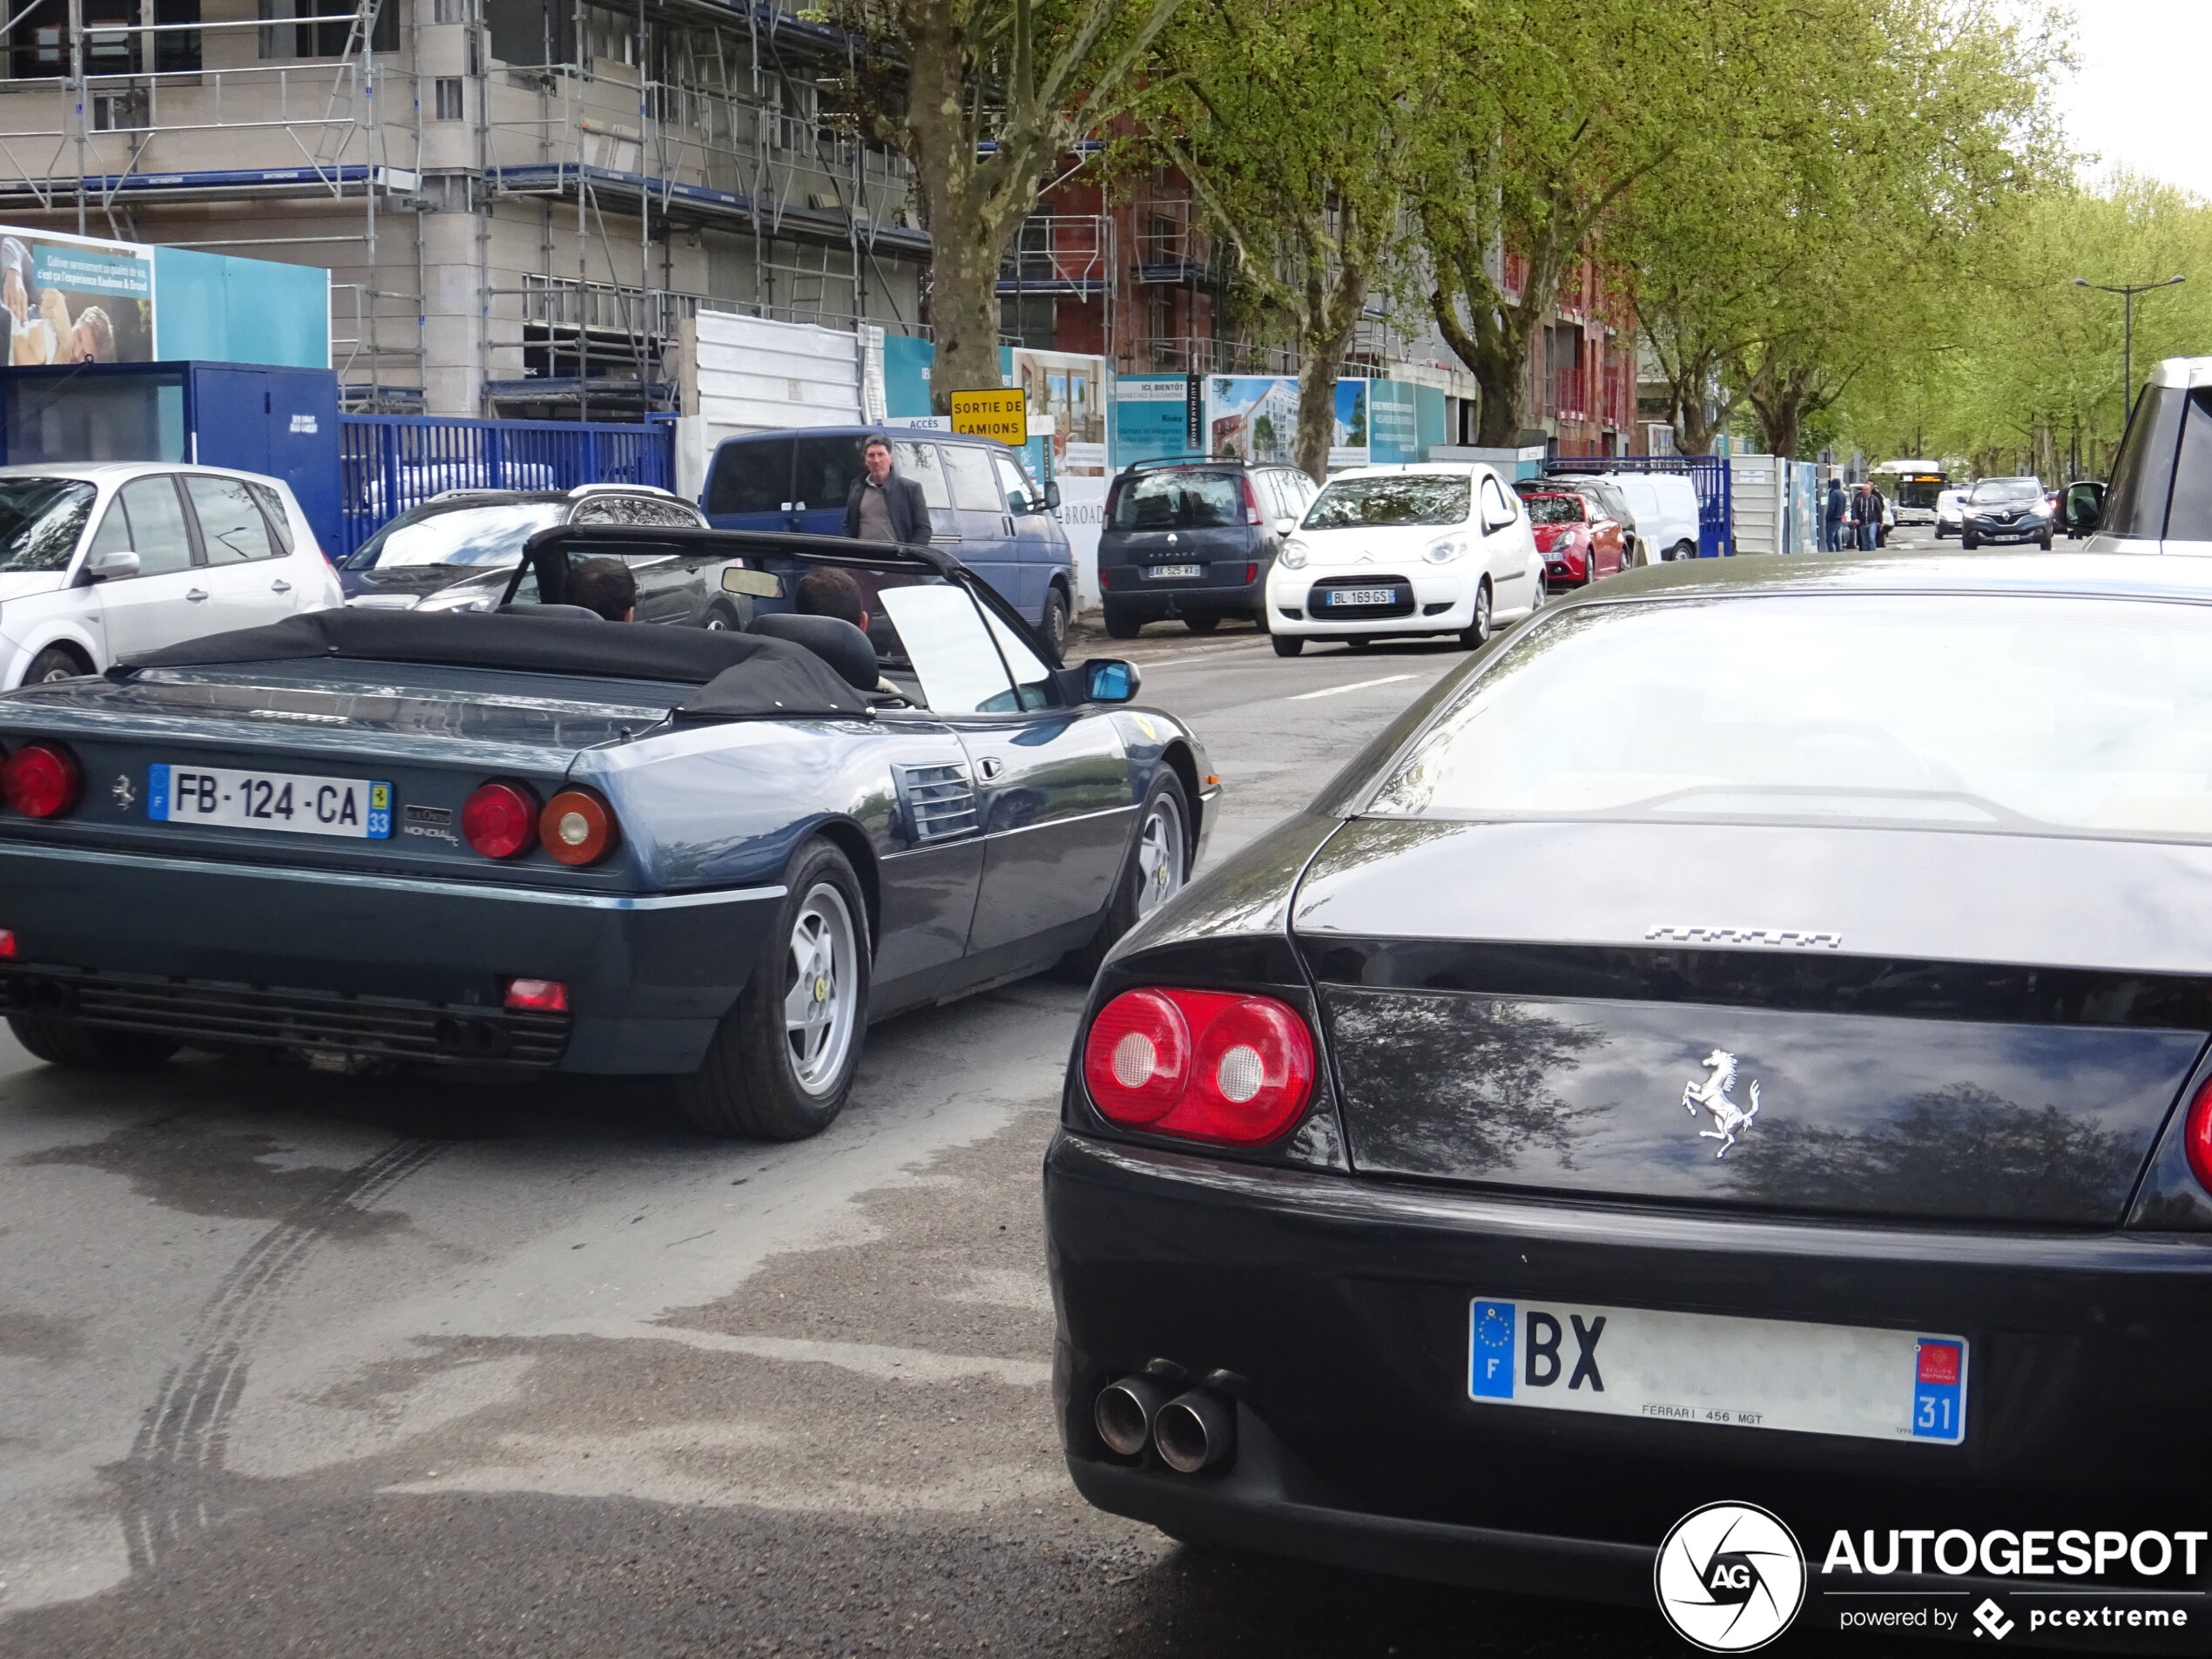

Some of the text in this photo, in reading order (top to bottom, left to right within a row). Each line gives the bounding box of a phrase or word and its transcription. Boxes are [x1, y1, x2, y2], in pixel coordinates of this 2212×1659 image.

[1154, 382, 1184, 391] BIENTÔT
[954, 401, 1022, 414] SORTIE DE
[910, 418, 939, 429] ACCÈS
[959, 422, 1019, 435] CAMIONS
[176, 772, 360, 826] FB-124-CA
[368, 812, 389, 833] 33
[1486, 1358, 1500, 1379] F
[1642, 1404, 1764, 1425] FERRARI 456 MGT
[1918, 1395, 1951, 1430] 31
